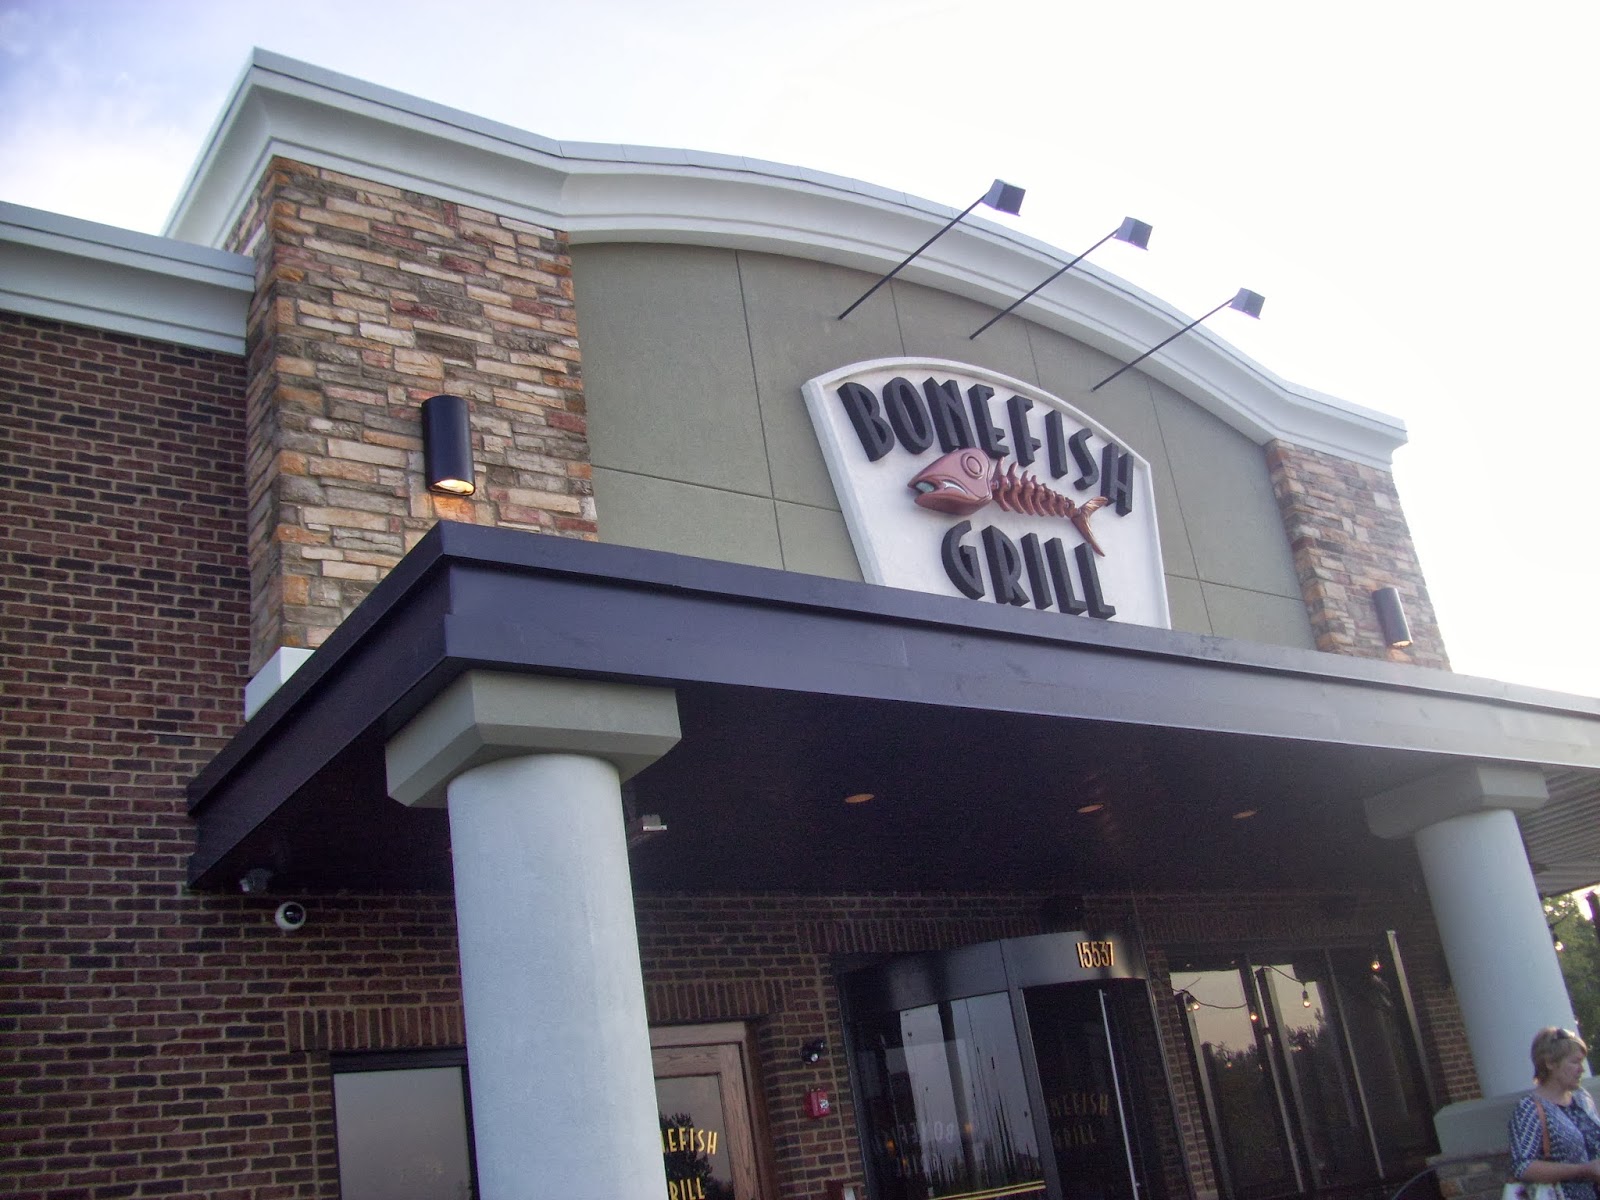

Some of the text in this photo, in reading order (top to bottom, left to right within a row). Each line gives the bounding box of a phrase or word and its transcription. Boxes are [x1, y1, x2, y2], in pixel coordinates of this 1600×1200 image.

[837, 376, 1134, 517] BONEFISH
[941, 519, 1116, 620] GRILL
[1075, 941, 1114, 968] 15537
